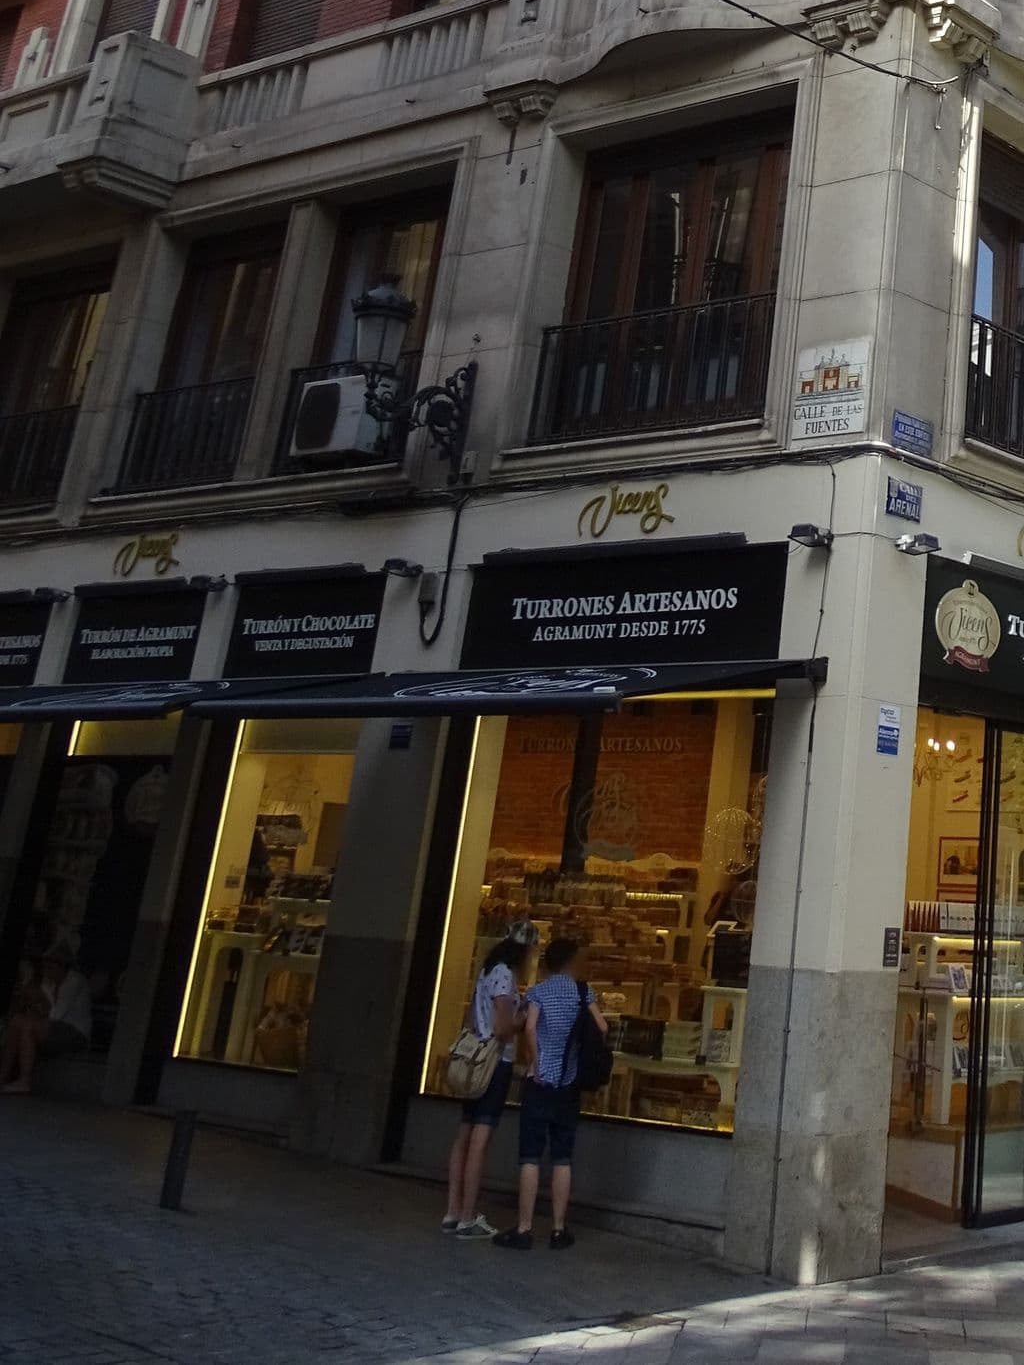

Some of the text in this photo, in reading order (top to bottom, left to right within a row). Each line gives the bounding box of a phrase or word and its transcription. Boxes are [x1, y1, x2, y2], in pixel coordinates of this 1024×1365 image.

[793, 403, 863, 421] CALLE DE LAS
[804, 418, 850, 435] FUENTES
[578, 483, 675, 537] Vicens
[888, 498, 920, 519] ARENAL
[513, 587, 738, 620] TURRONES ARTESANOS
[137, 625, 197, 642] AGRAMUNT
[242, 615, 294, 634] TURRÓN
[302, 614, 376, 632] CHOCOLATE
[532, 619, 706, 641] AGRAMUNT DESDE 1775
[941, 607, 994, 652] Vicens
[255, 638, 283, 651] VENTA
[291, 633, 355, 650] DEGUSTACIÓN
[519, 736, 683, 754] TURRON ARTESANOS
